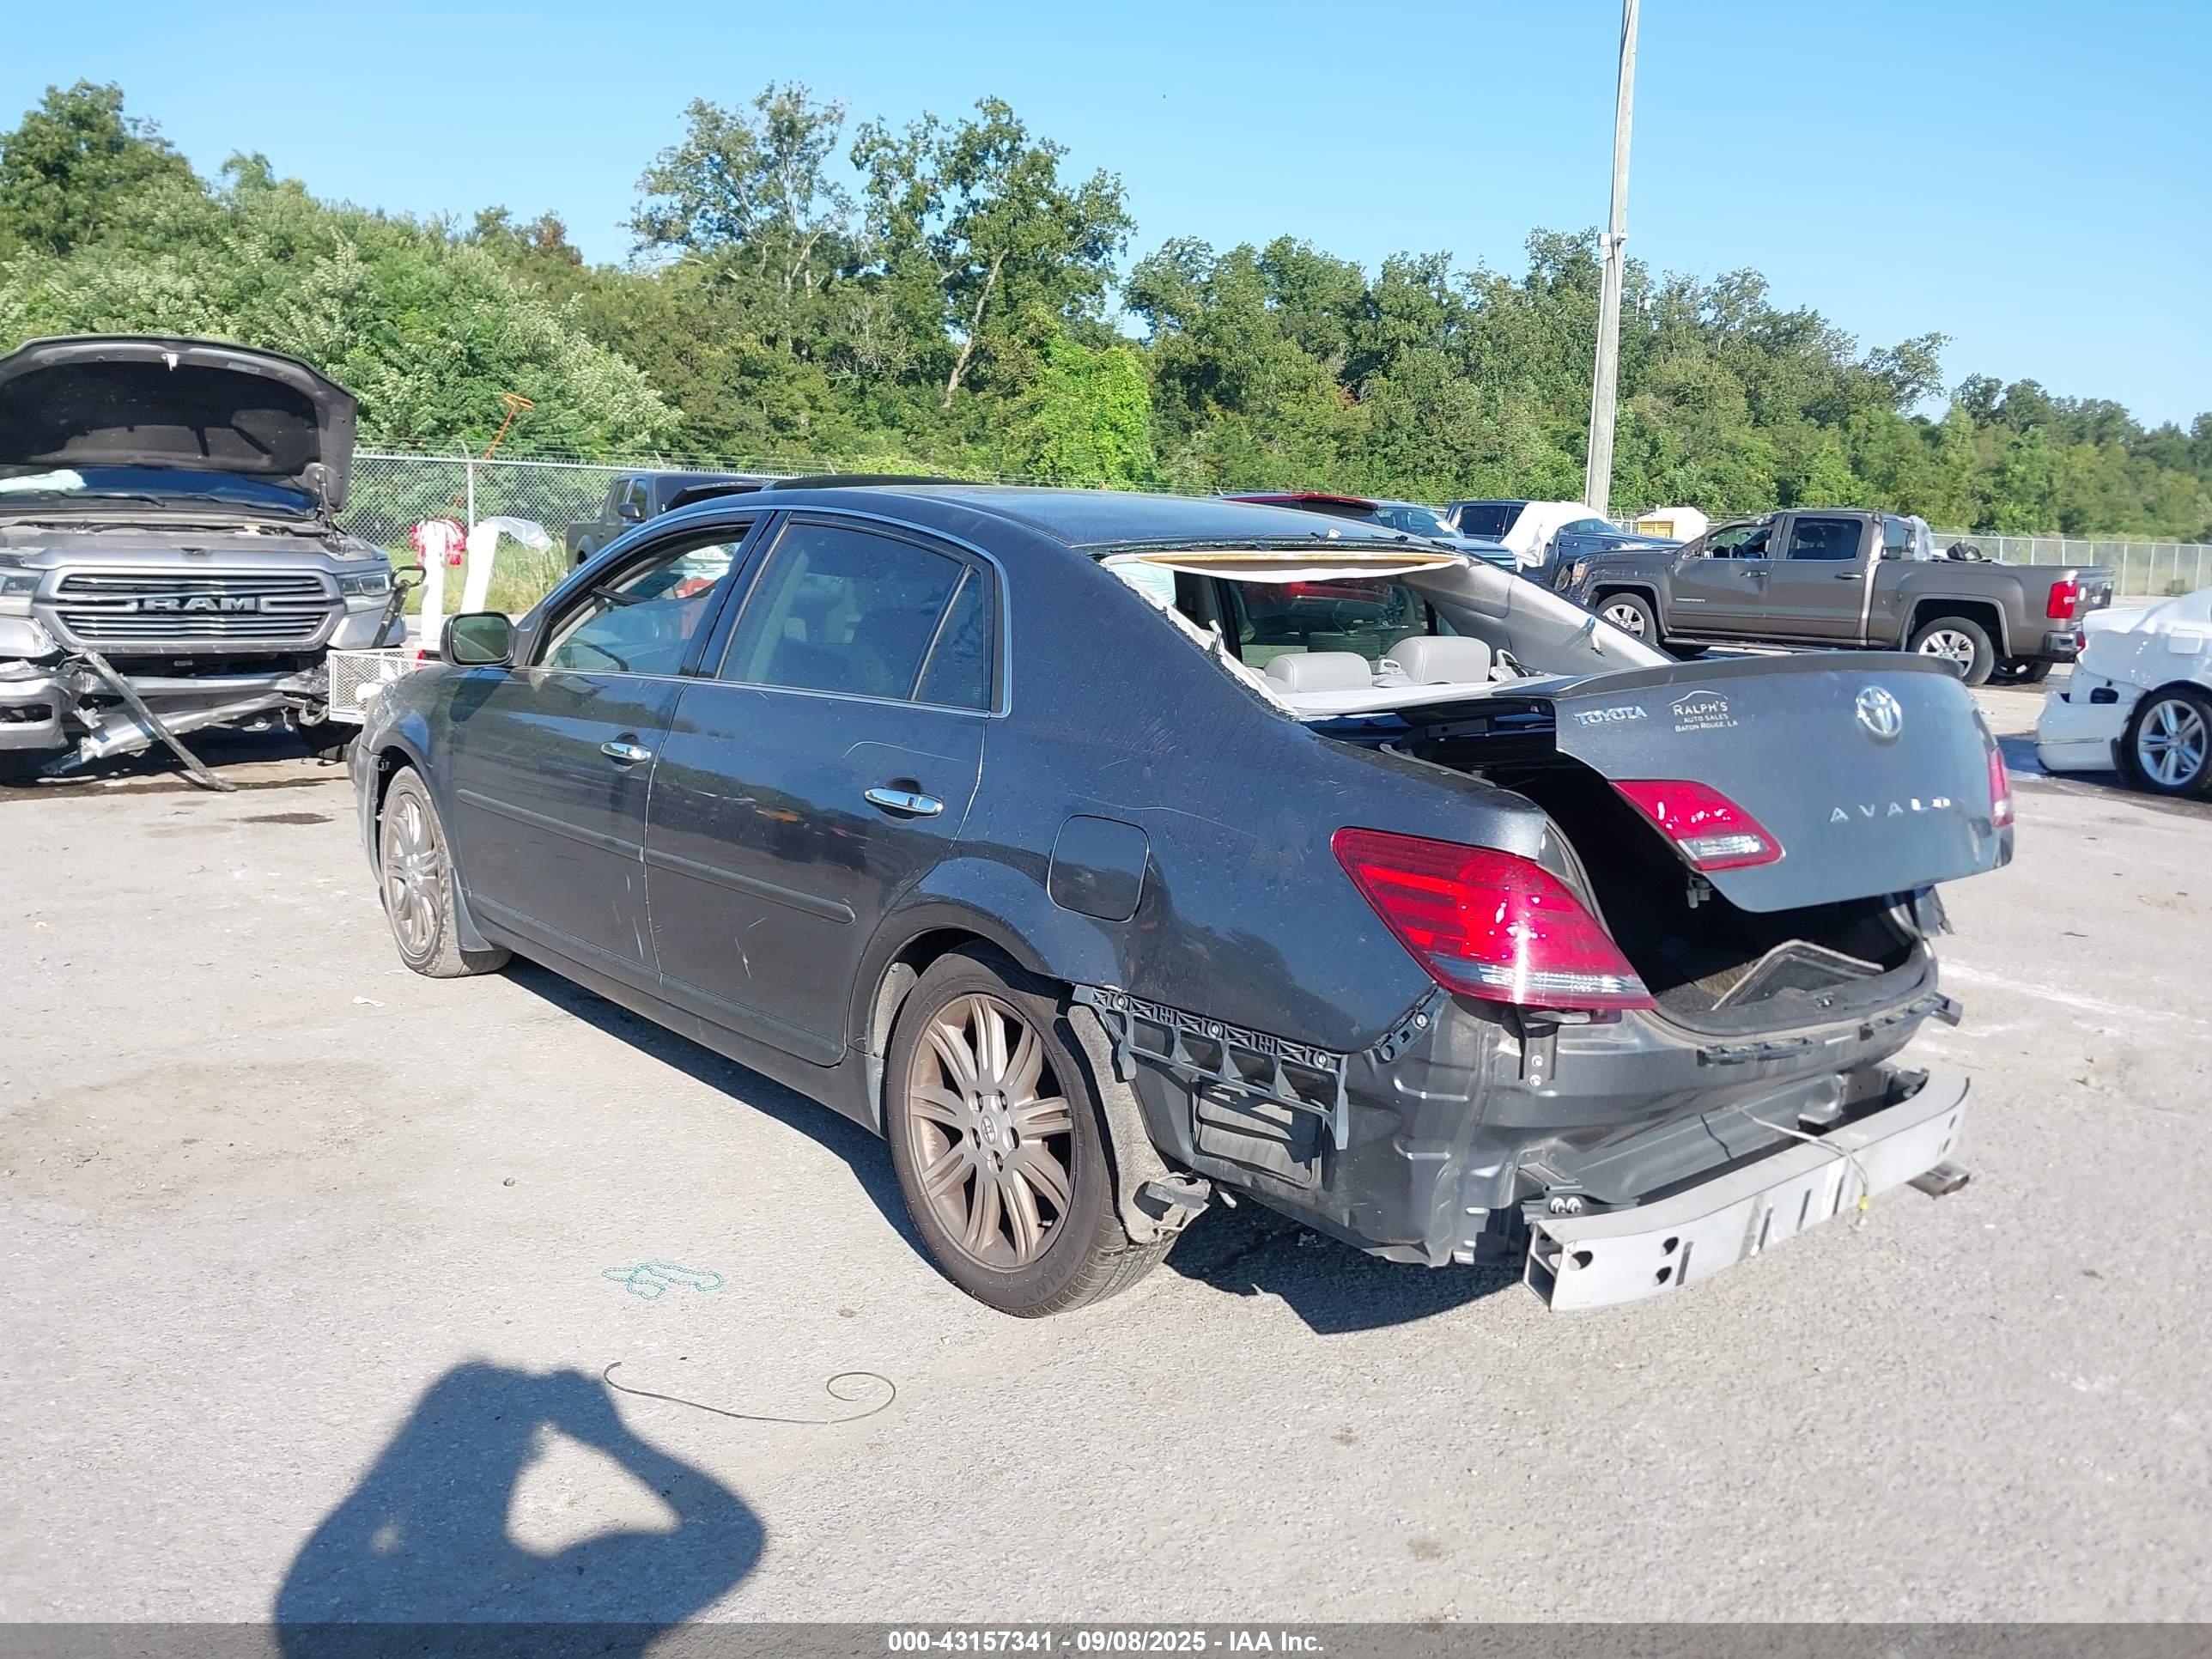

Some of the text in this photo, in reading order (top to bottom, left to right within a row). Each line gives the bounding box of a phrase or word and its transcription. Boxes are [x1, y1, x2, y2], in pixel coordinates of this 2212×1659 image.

[143, 597, 256, 611] RAM
[1574, 706, 1647, 726] TOYOTA
[1673, 701, 1728, 715] RALPH'S
[1828, 796, 1962, 823] AVALO
